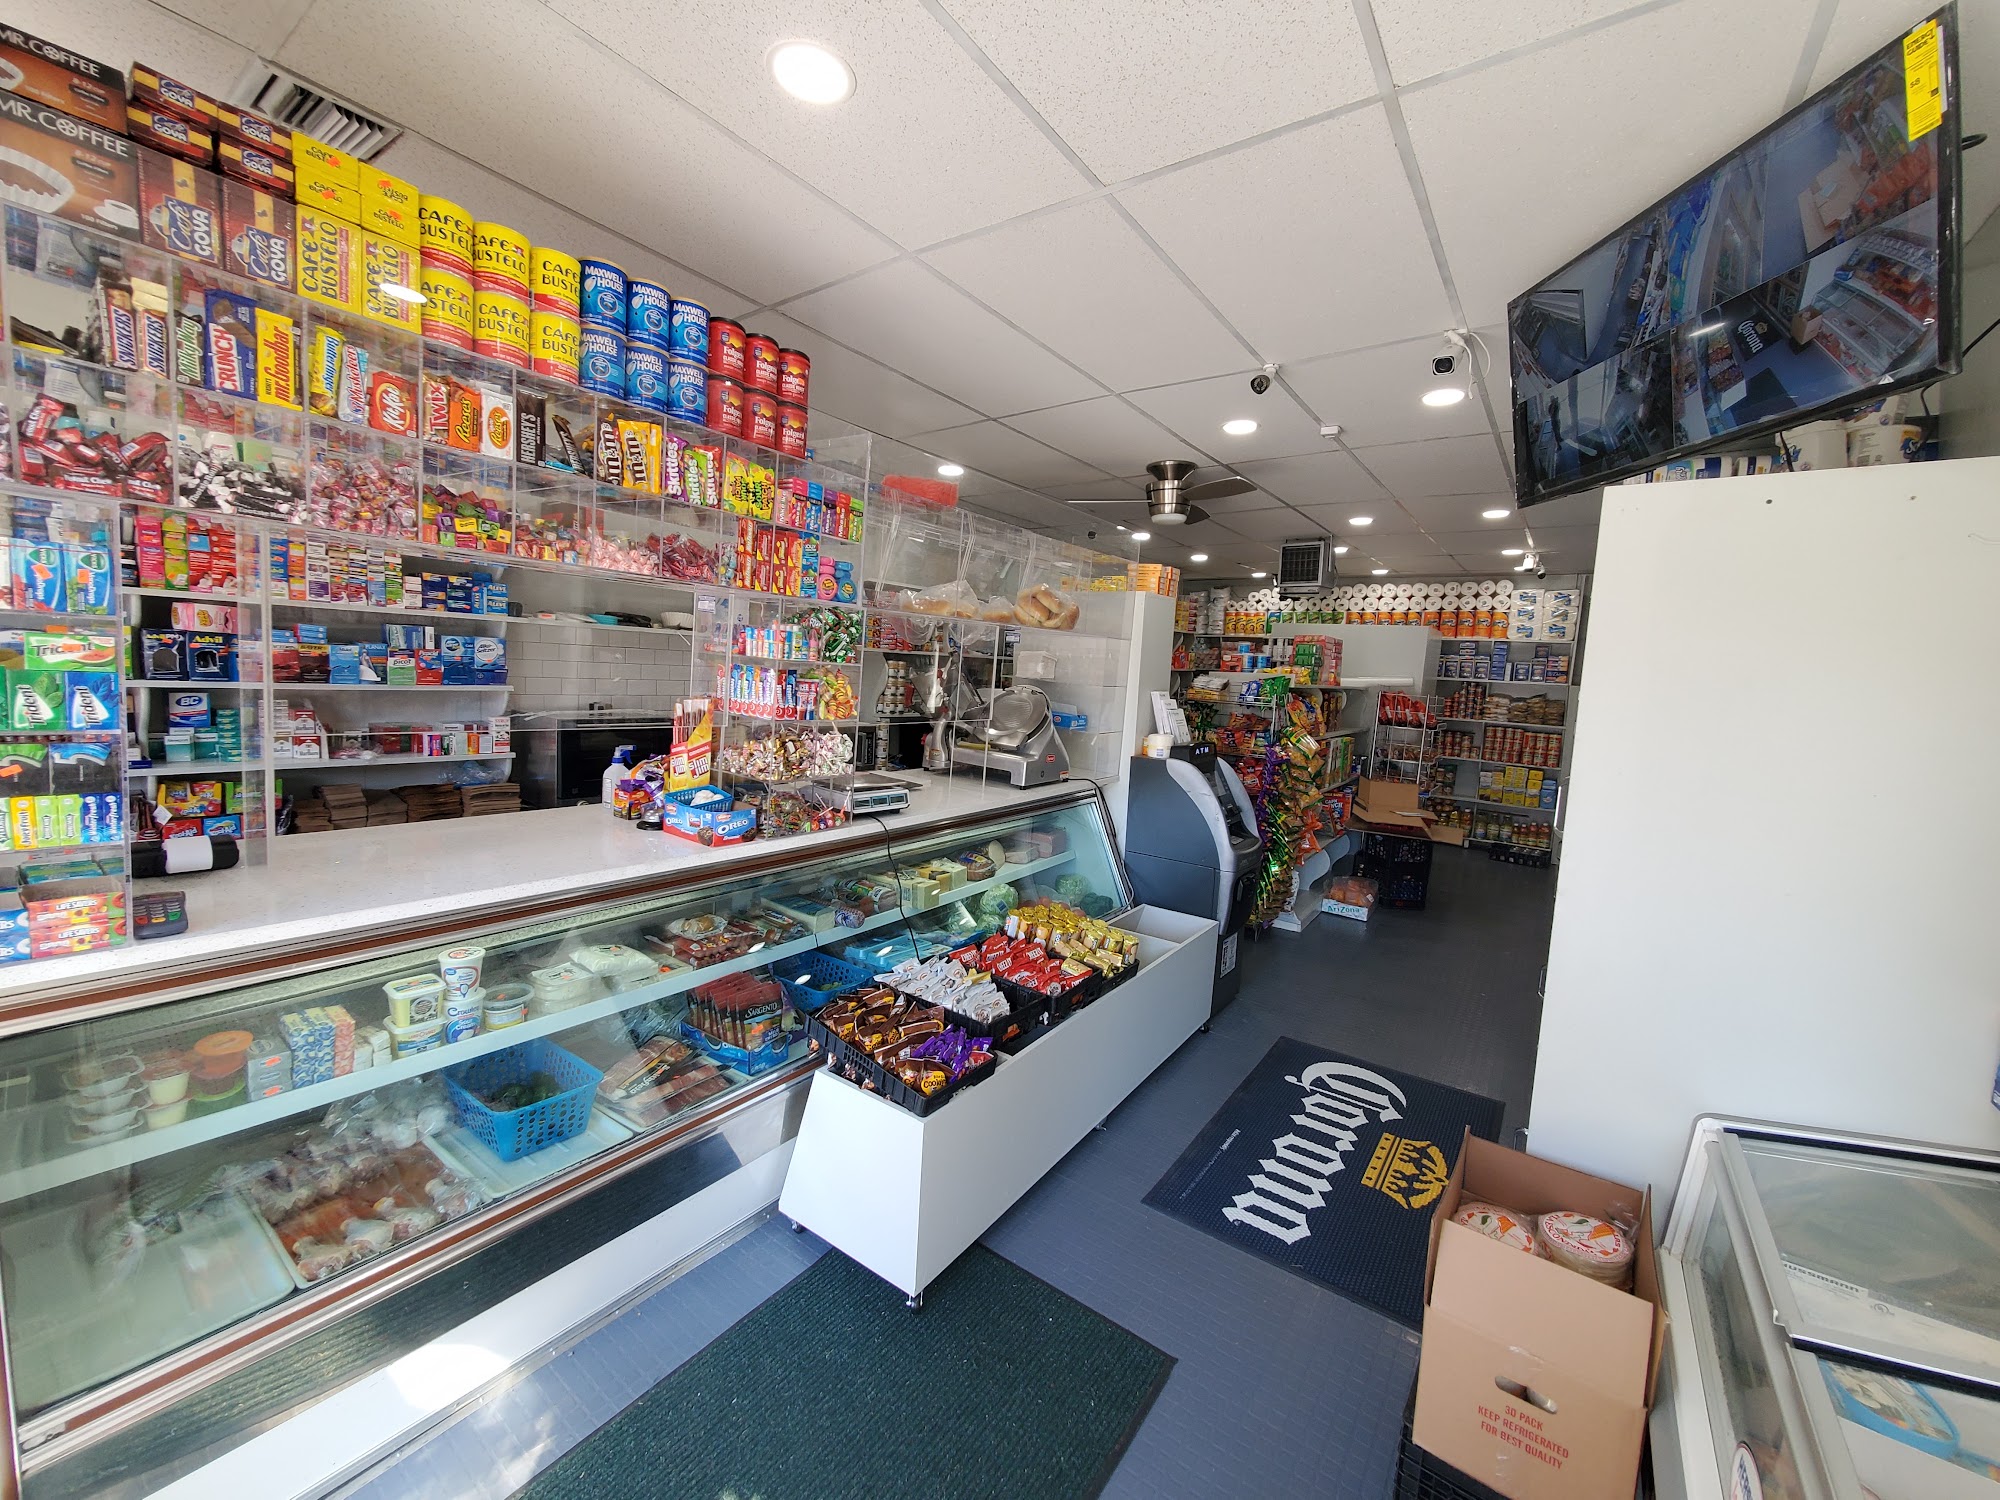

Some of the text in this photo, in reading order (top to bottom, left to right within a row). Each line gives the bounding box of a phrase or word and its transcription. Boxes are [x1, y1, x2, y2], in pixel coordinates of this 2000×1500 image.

[28, 39, 100, 77] COFFEE
[160, 88, 195, 110] GOYA
[38, 110, 129, 158] COFFEE
[153, 122, 188, 144] GOYA
[242, 125, 272, 144] GOYA
[243, 157, 273, 177] GOYA
[306, 149, 341, 169] BUST
[193, 208, 211, 256] GOYA
[420, 222, 472, 252] BUSTEL
[270, 237, 287, 282] GOYA
[320, 221, 338, 299] BUSTELO
[542, 273, 580, 297] BUSTE
[585, 265, 624, 284] MAXWELL
[597, 276, 624, 294] HOUSE
[421, 281, 457, 300] AFE
[632, 283, 668, 303] MAXWELL
[421, 297, 471, 323] STELO
[644, 294, 668, 311] HOUSE
[673, 302, 708, 320] MAXWELL
[684, 313, 708, 328] HOUSE
[113, 308, 137, 368] SNICKERS
[146, 316, 166, 373] SNICKERS
[580, 332, 618, 349] MAXWELL
[1737, 320, 1764, 354] Corona
[214, 326, 239, 392] CRUNCH
[542, 338, 580, 361] BUSTE
[589, 342, 618, 357] HOUSE
[626, 350, 663, 367] MAXWELL
[324, 335, 339, 396] Butterfinger
[637, 360, 663, 374] HOUSE
[670, 364, 704, 382] MAXWELL
[680, 373, 704, 387] HOUSE
[430, 383, 448, 431] TWIX
[520, 412, 536, 464] HERSHEY'S
[668, 442, 682, 496] Skittles
[690, 459, 701, 506] Skittles
[193, 635, 223, 644] Advil
[17, 685, 46, 729] Trident
[75, 686, 102, 728] Trident
[180, 696, 200, 706] BC
[1195, 746, 1210, 755] ATM
[665, 817, 684, 826] OREO
[717, 819, 748, 835] OREO
[1327, 905, 1360, 914] AriZona
[745, 1002, 777, 1019] SARGENTO
[1221, 1060, 1408, 1245] Corona
[1477, 1405, 1569, 1459] KEEP REFRIGERATED
[1519, 1412, 1544, 1431] PACK
[1480, 1420, 1563, 1469] FOR BEST QUALITY
